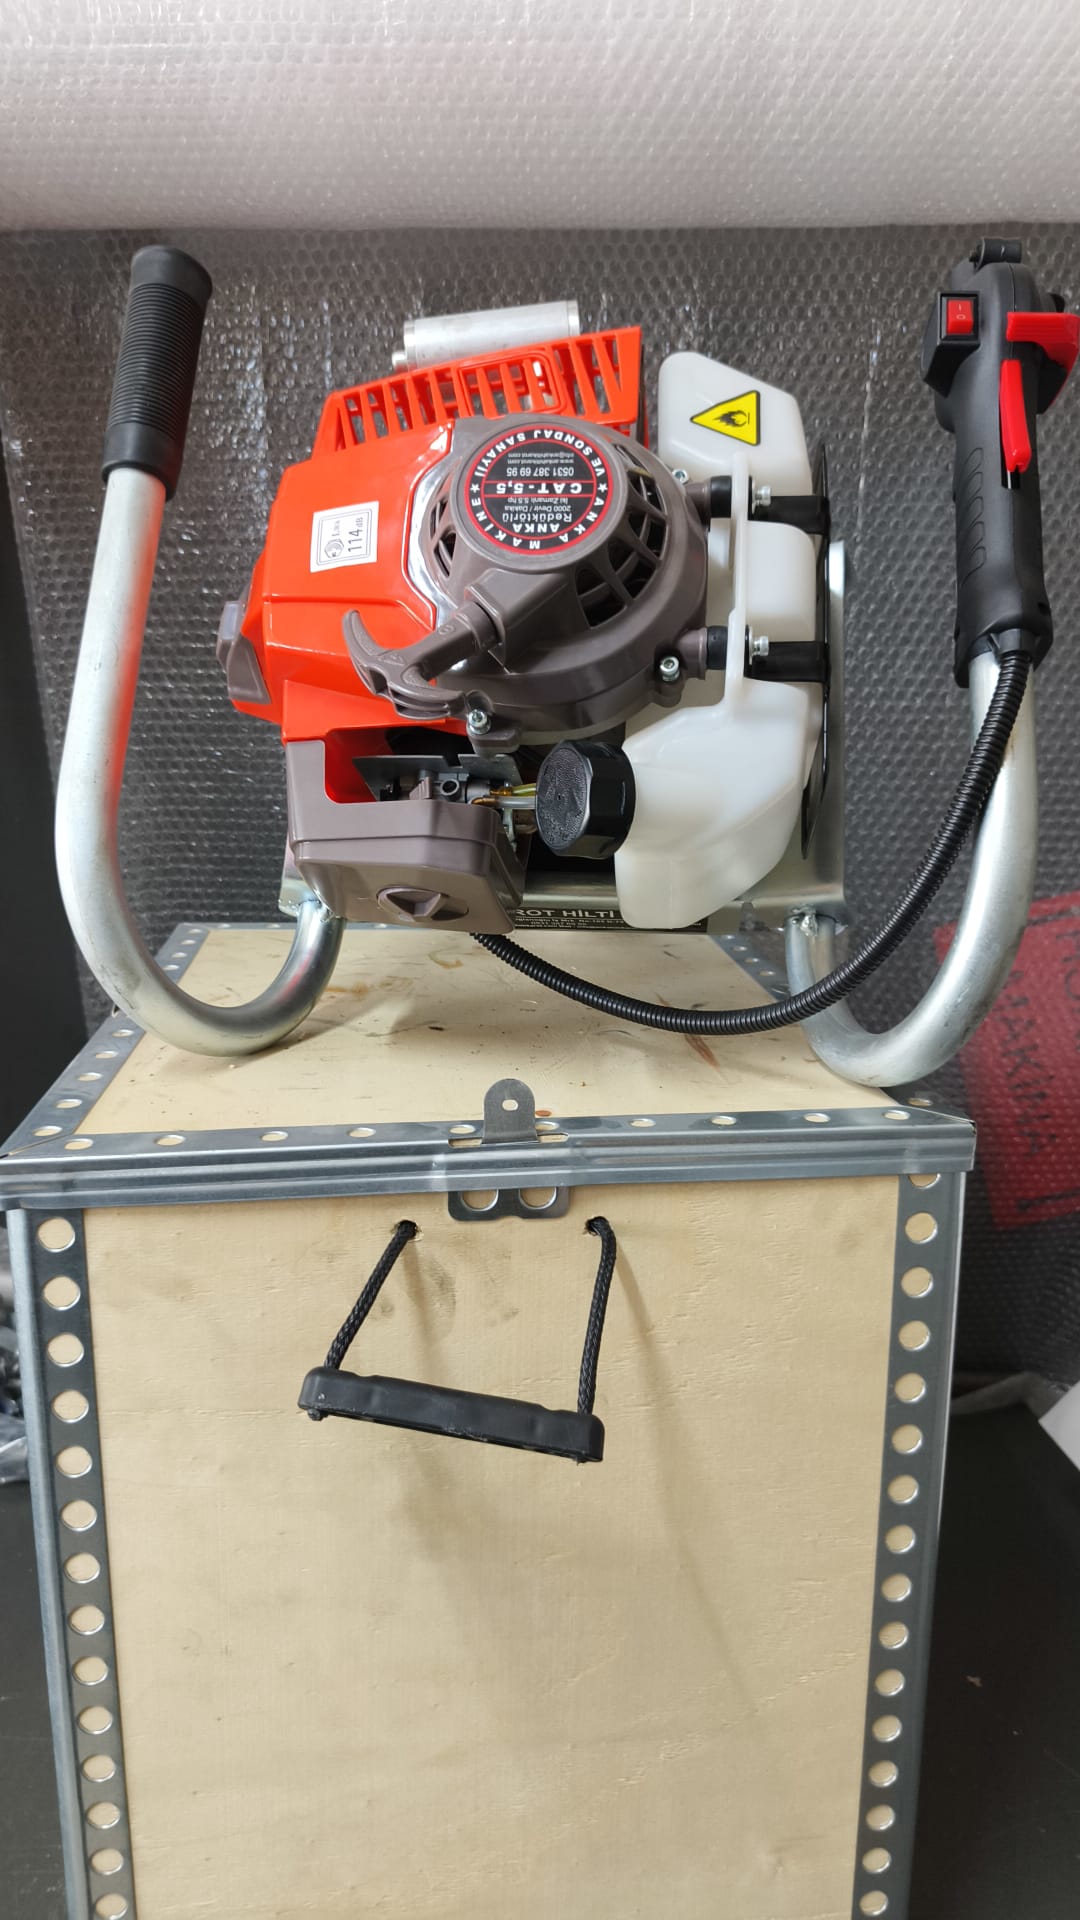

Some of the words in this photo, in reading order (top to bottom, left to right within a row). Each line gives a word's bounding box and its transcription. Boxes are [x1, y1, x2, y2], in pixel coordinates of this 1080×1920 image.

[533, 429, 593, 455] SONDAJ
[506, 466, 519, 477] 95
[519, 466, 532, 477] 69
[533, 466, 550, 477] 387
[552, 466, 575, 477] 0531
[590, 457, 606, 476] VE
[501, 512, 573, 523] Redüktörlü
[558, 495, 605, 542] ANKA
[511, 523, 560, 533] ANKA
[347, 529, 363, 553] 114
[514, 908, 555, 917] ROT
